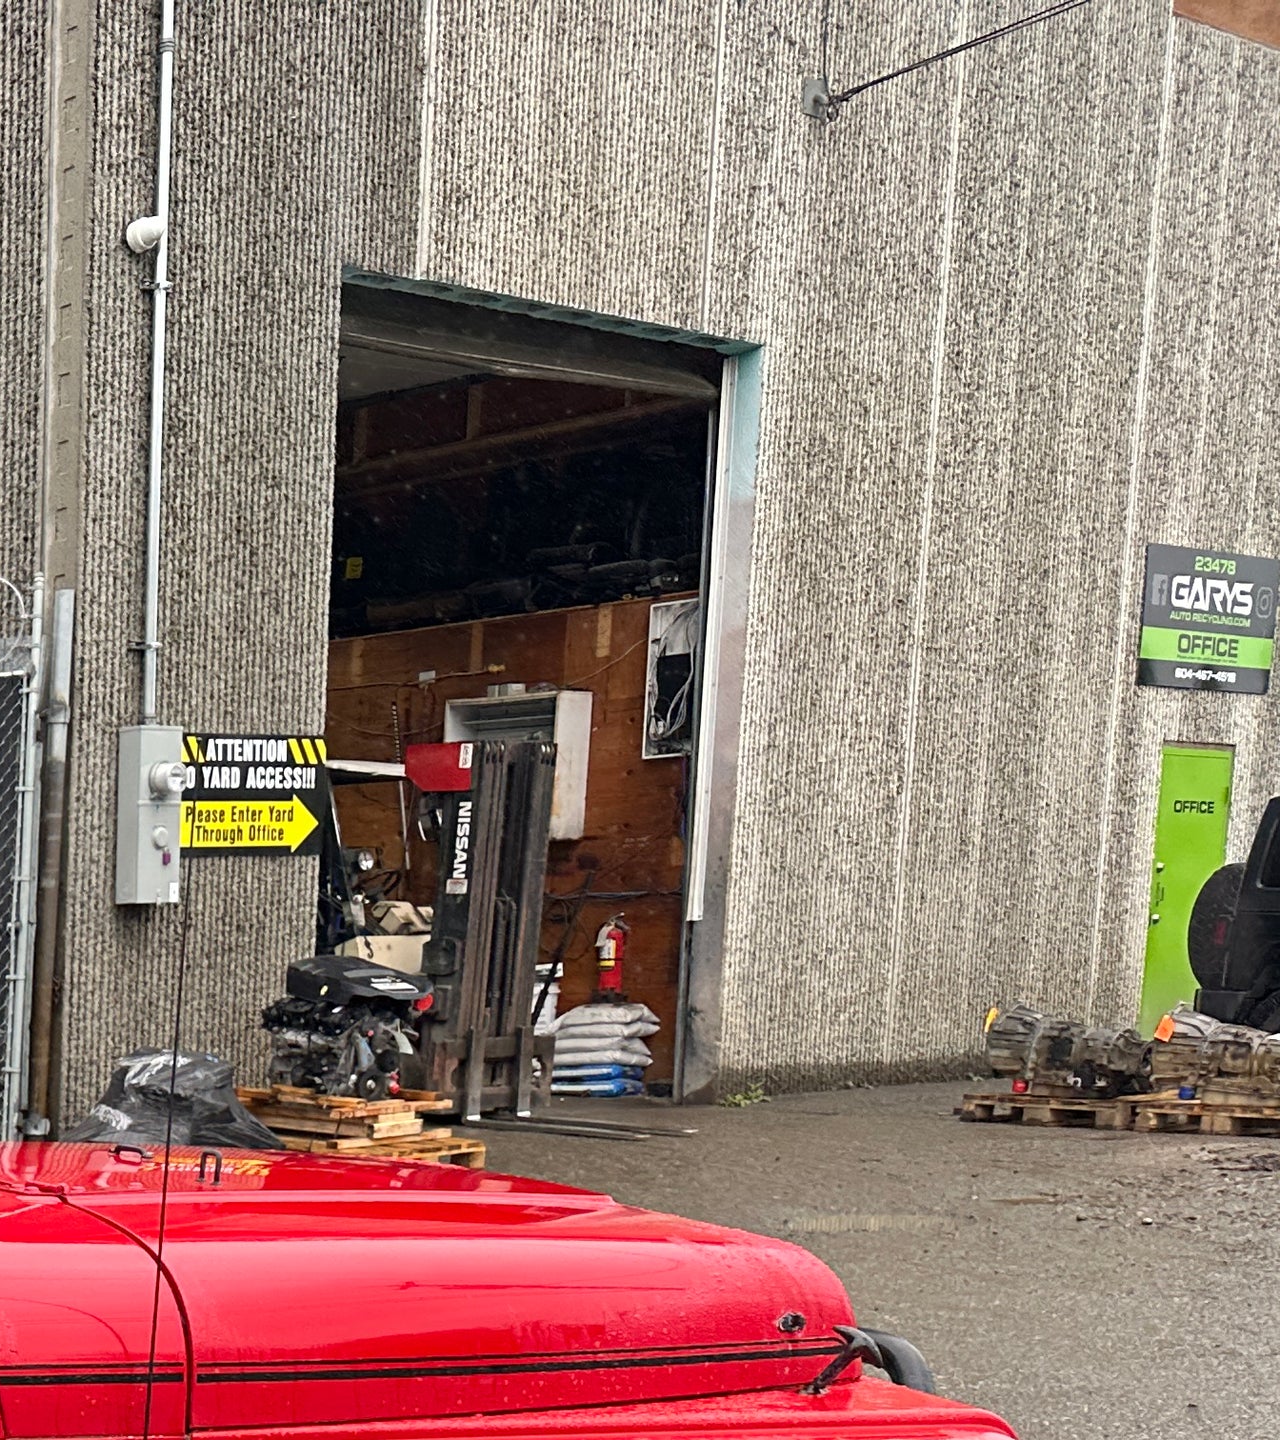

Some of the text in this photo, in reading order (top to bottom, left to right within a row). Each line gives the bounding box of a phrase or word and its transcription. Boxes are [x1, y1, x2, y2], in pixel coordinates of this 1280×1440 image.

[1194, 556, 1236, 575] 23478
[1171, 575, 1255, 616] GARYS
[1169, 610, 1191, 621] AUTO
[1177, 633, 1239, 658] OFFICE
[205, 738, 288, 763] ATTENTION
[186, 766, 316, 790] O YARD ACCESS!!!
[186, 805, 294, 823] Please Enter Yard
[1163, 800, 1215, 814] OFFICE
[195, 825, 285, 845] Through Office
[453, 801, 472, 878] NISSAN
